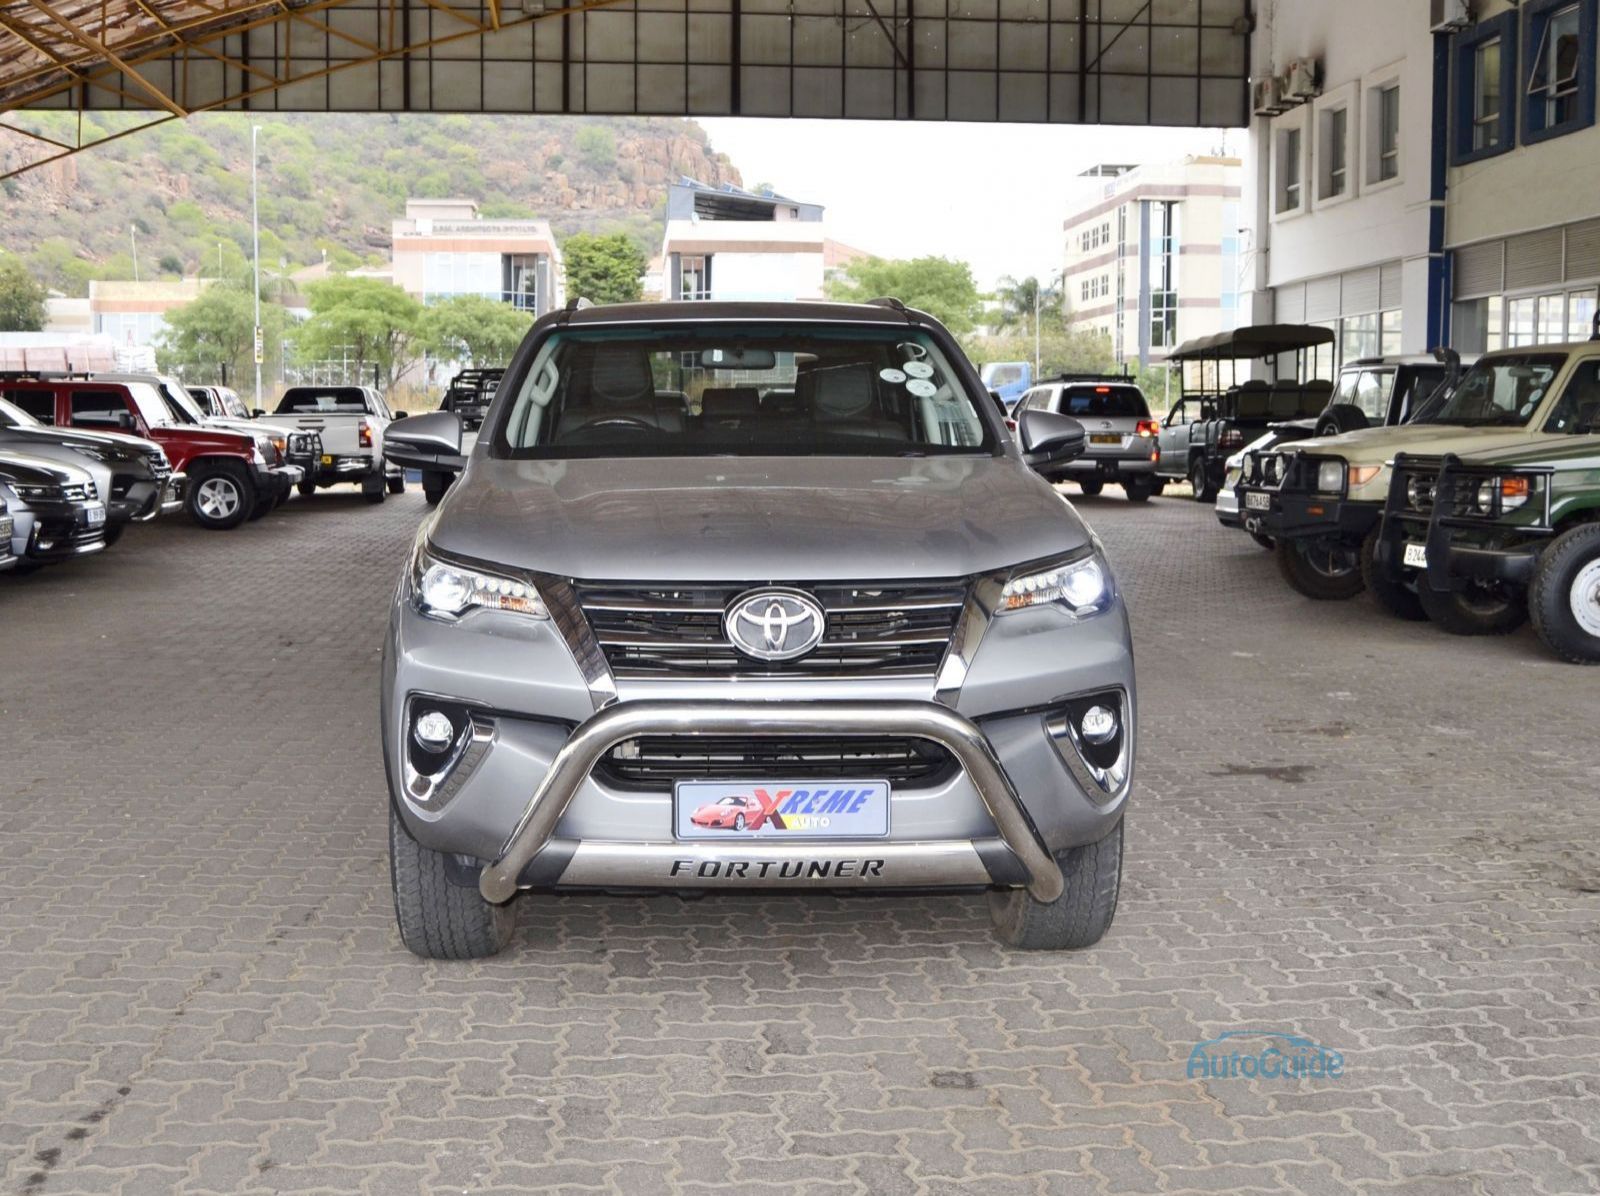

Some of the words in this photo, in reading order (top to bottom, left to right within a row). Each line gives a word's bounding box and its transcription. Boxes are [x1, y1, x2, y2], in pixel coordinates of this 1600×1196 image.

[747, 788, 875, 831] XREME
[791, 816, 831, 828] AUTO
[670, 859, 885, 878] FORTUNER
